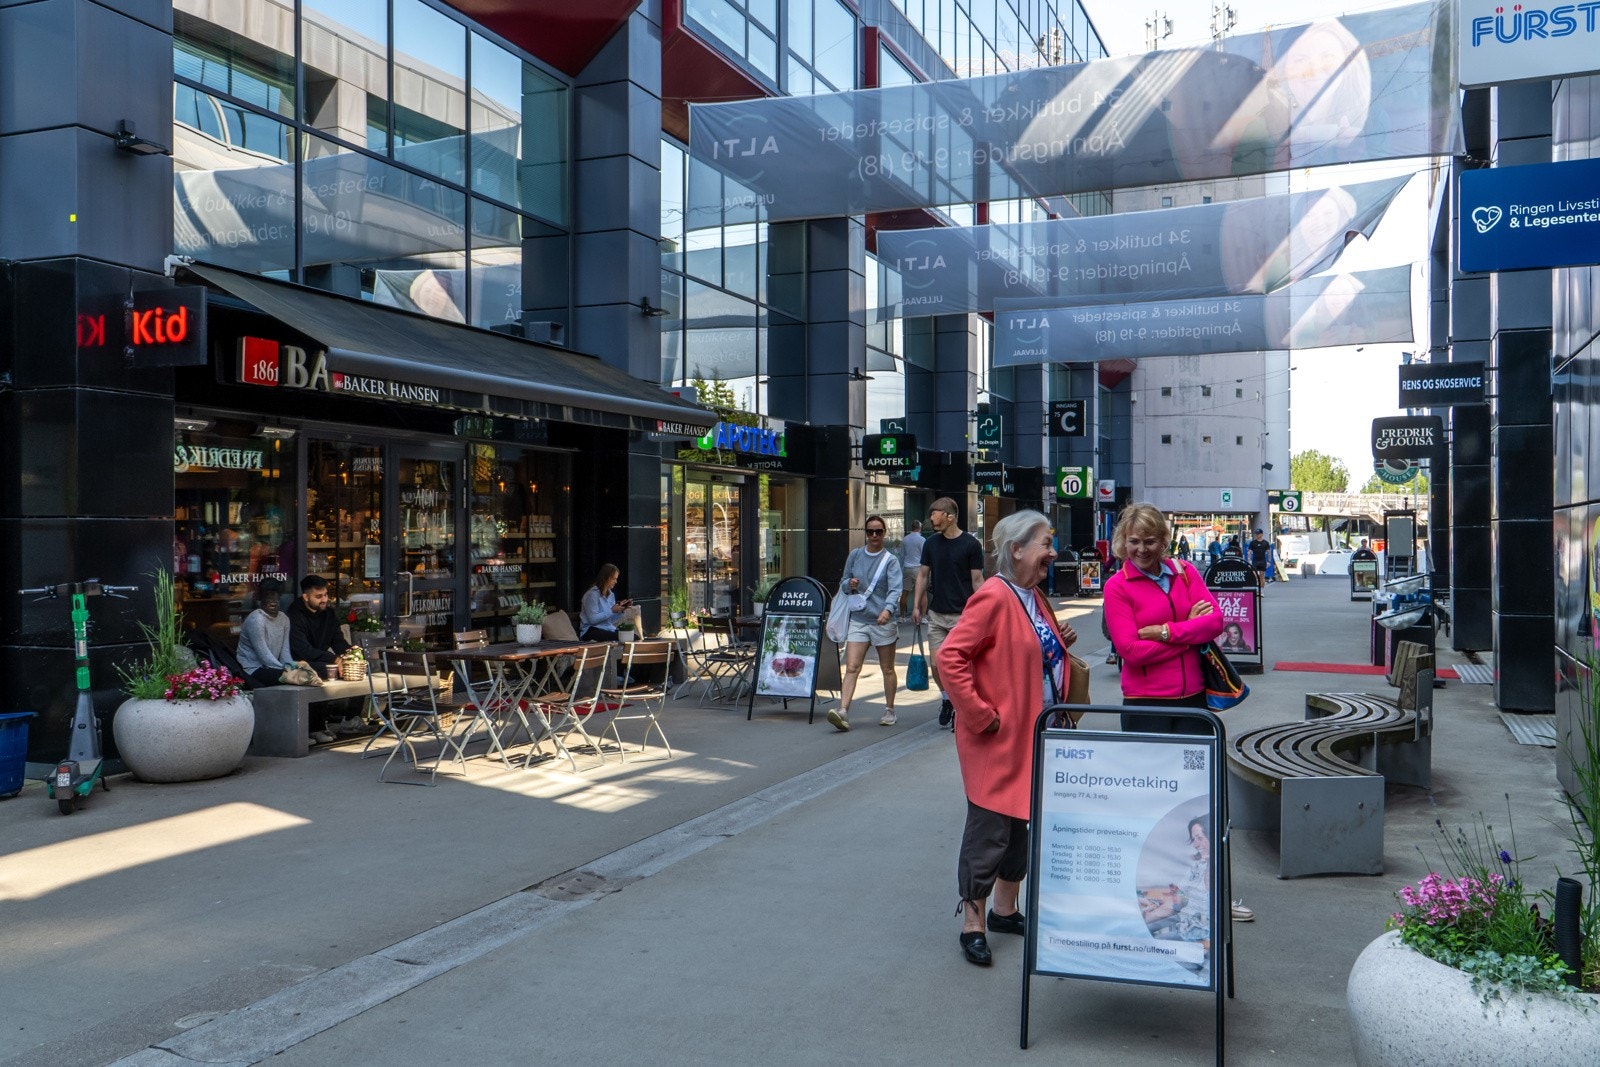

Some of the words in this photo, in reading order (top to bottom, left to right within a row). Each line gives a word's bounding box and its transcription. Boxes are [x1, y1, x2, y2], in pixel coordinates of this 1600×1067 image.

[1472, 1, 1600, 47] FÜRST
[1509, 204, 1555, 216] Ringen
[1558, 198, 1599, 211] Livssti
[1509, 217, 1520, 228] &
[133, 305, 187, 345] Kid
[252, 360, 279, 382] 1861
[343, 375, 388, 396] BAKER
[390, 382, 440, 403] HANSEN
[1402, 380, 1421, 390] RENS
[1422, 379, 1434, 390] OG
[1435, 377, 1481, 389] SKOSERVICE
[1061, 411, 1077, 432] C
[663, 421, 683, 435] BAKER
[684, 424, 710, 437] HANSEN
[1381, 427, 1434, 438] FREDRIK
[716, 421, 778, 456] APOTEK
[1375, 436, 1434, 450] &LOUISA
[867, 458, 904, 466] APOTEK
[905, 458, 910, 466] 1
[1064, 480, 1080, 493] 10
[1287, 500, 1294, 509] 9
[481, 565, 500, 573] BAKER
[501, 564, 522, 573] HANSEN
[221, 574, 250, 584] BAKER
[1218, 597, 1241, 607] TAX
[1055, 746, 1094, 760] FÜRST
[1055, 771, 1179, 793] Blodprøvetaking
[1053, 791, 1077, 799] Inngang
[1052, 824, 1095, 834] Åpningstider
[1096, 828, 1139, 838] prøvetaking:
[1052, 843, 1075, 851] Mandag
[1050, 873, 1071, 881] Fredag
[1049, 936, 1100, 950] Timebestilling
[1101, 941, 1111, 950] på
[1112, 942, 1177, 955] furst.no/ullevaal
